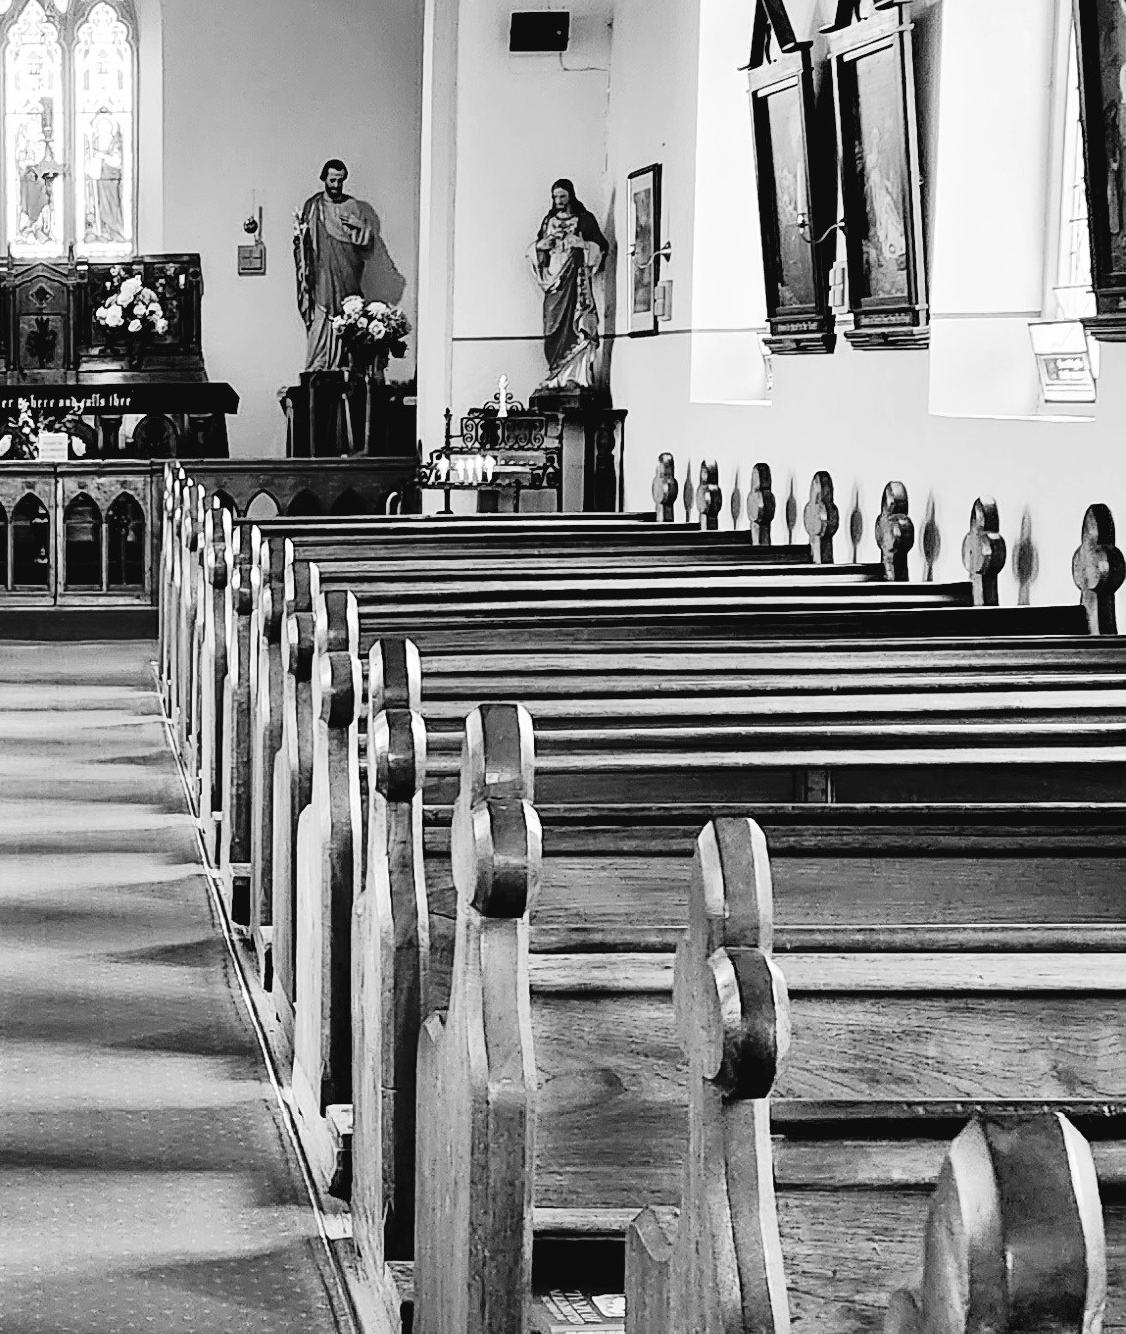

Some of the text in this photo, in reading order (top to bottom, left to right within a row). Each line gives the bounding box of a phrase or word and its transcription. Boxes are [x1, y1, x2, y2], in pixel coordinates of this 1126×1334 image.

[30, 394, 55, 408] here
[58, 396, 78, 408] and
[109, 393, 131, 407] thee
